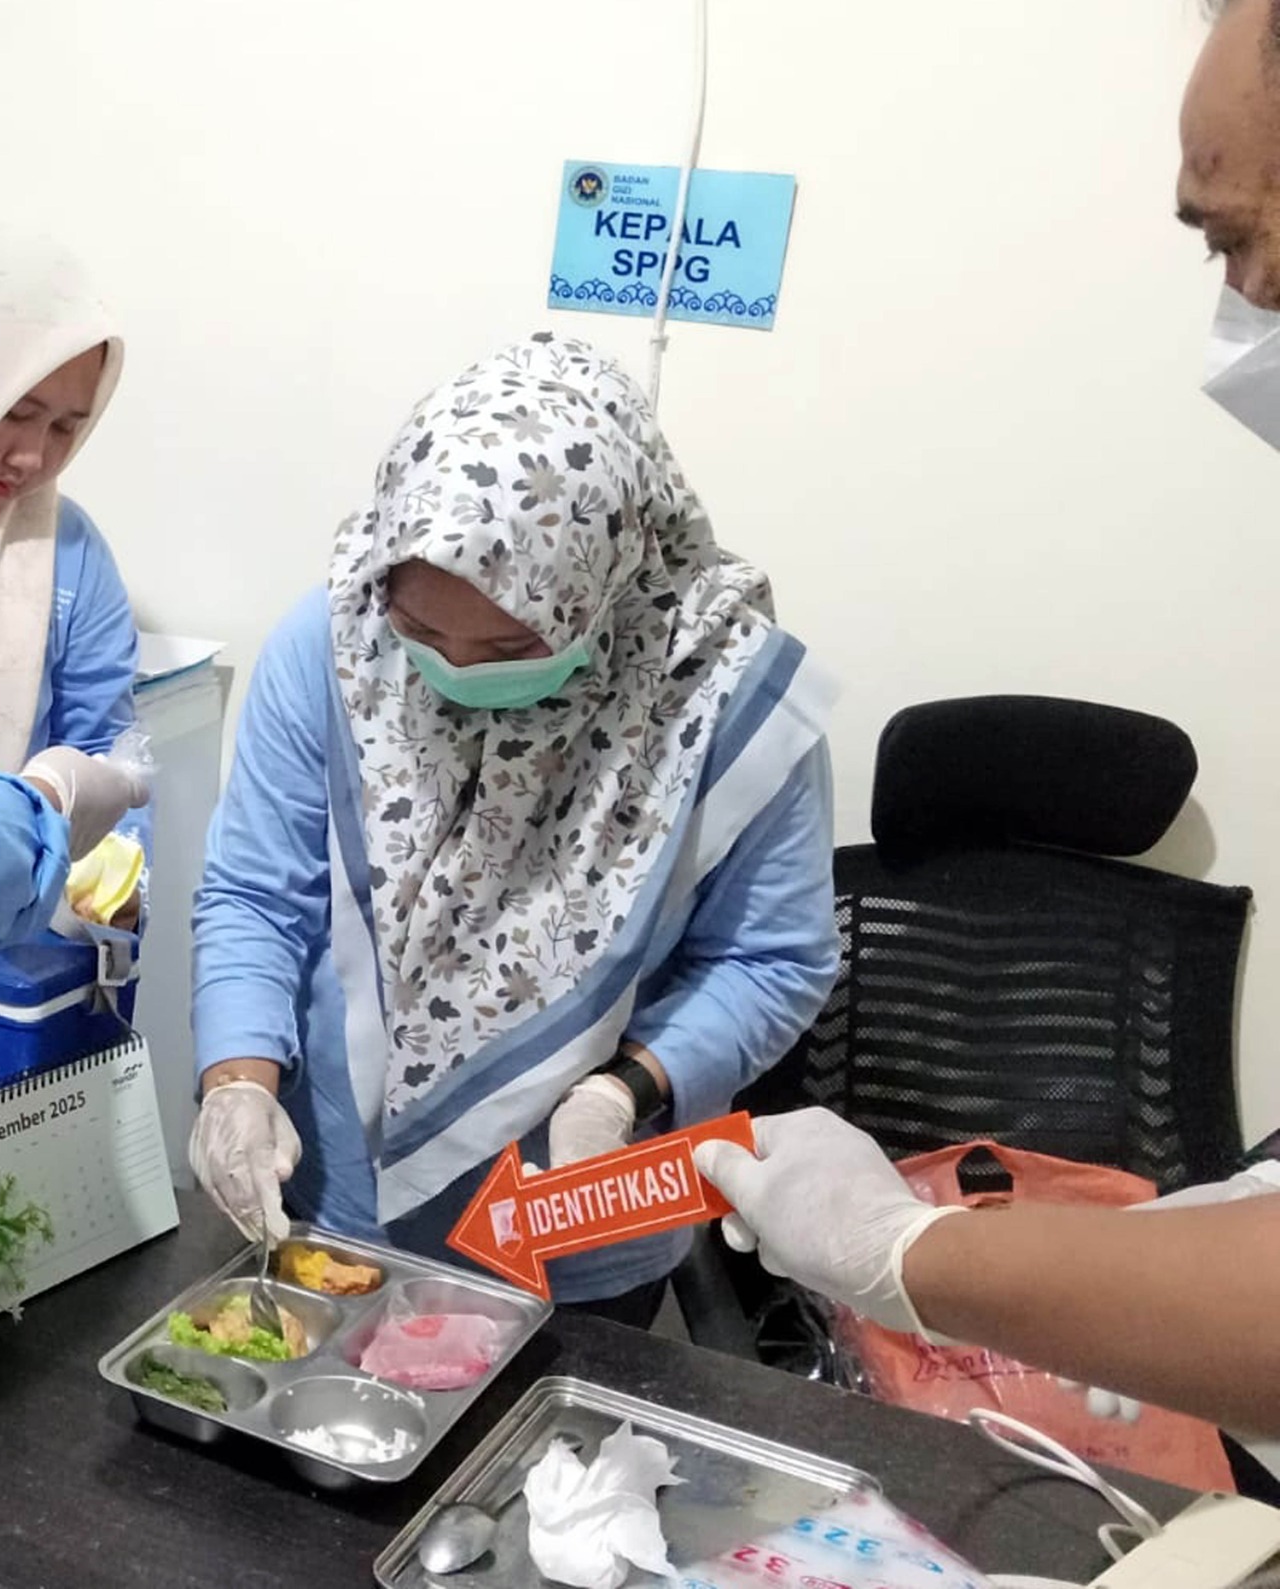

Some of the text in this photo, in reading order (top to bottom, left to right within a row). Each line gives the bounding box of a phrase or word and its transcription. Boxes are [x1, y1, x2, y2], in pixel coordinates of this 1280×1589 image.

[613, 175, 650, 186] BADAN
[610, 195, 662, 208] NASIONAL
[593, 209, 742, 249] KEPALA
[610, 248, 711, 284] SPPG
[49, 1090, 87, 1120] 2025
[524, 1157, 691, 1238] IDENTIFIKASI
